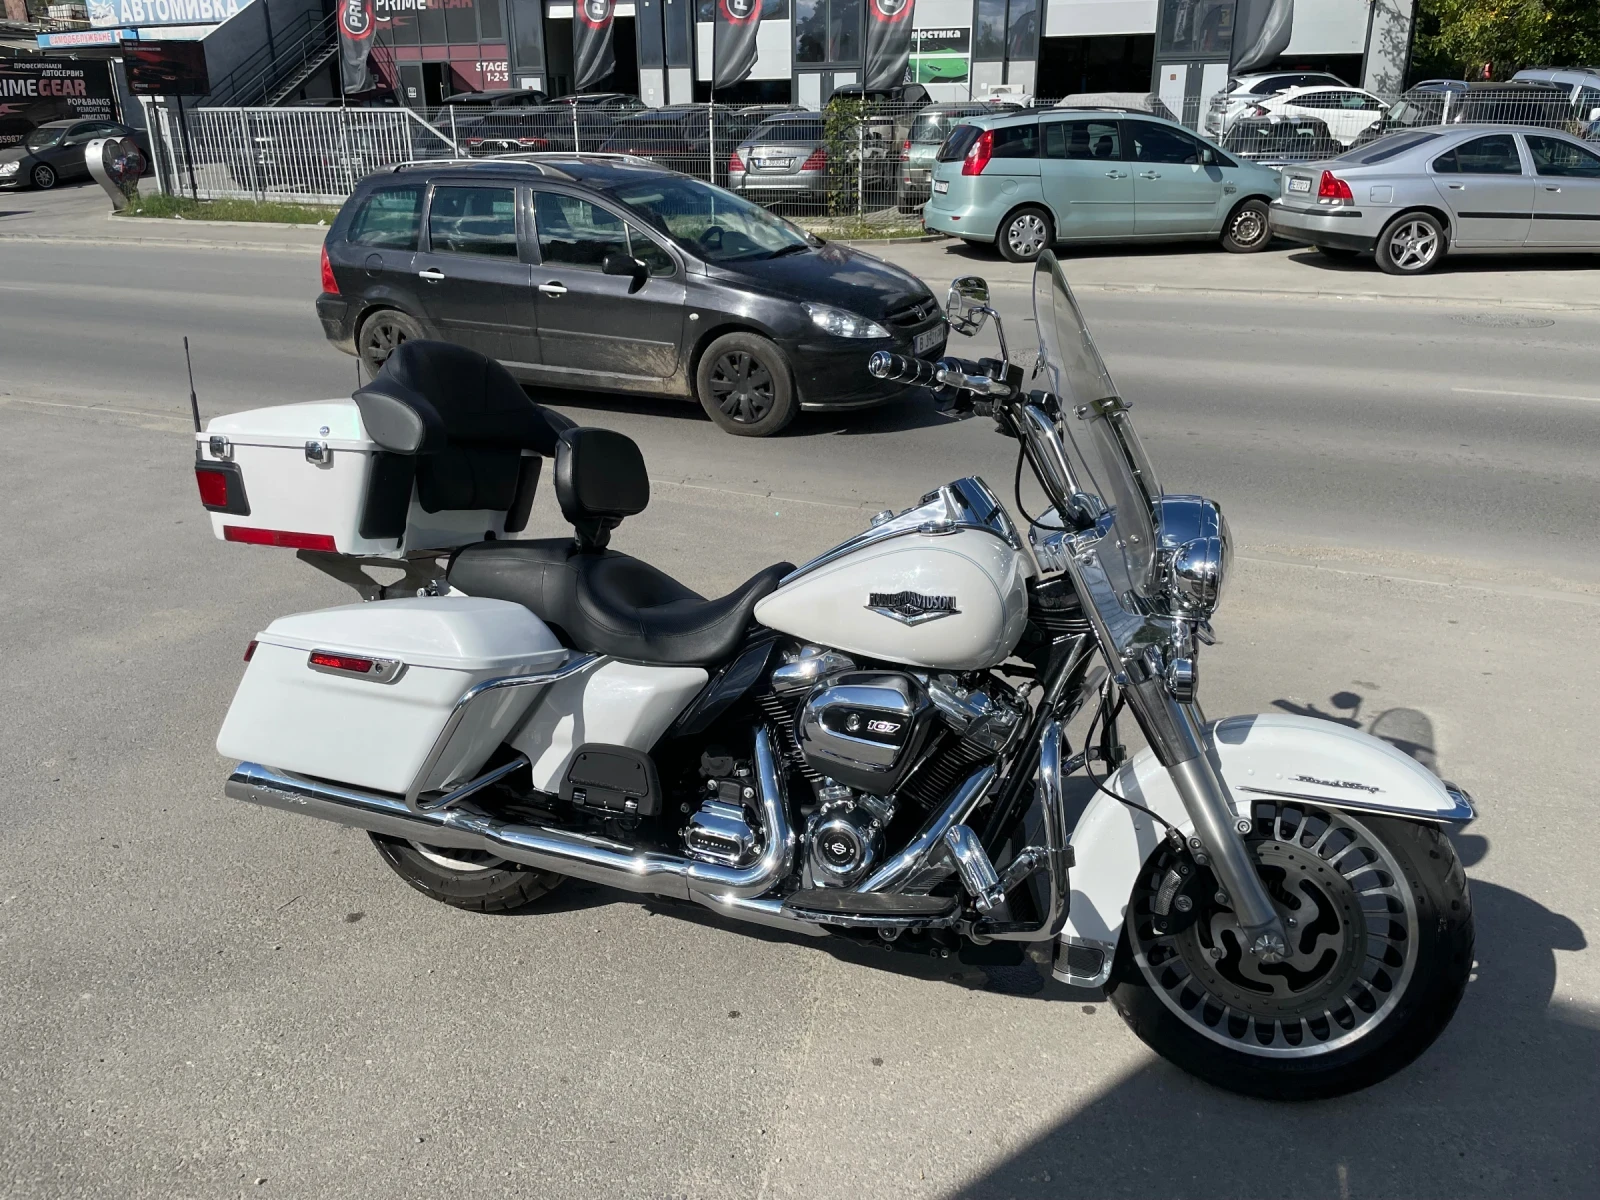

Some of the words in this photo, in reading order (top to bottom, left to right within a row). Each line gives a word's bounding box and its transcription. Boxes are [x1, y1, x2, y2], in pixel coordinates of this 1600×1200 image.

[120, 0, 239, 22] АВТОМИВКА
[475, 62, 508, 71] STAGE
[41, 69, 84, 77] АВТОСЕРВИЗ
[487, 73, 509, 82] 1-2-3
[38, 79, 87, 96] GEAR
[67, 98, 111, 106] POP&BANGS
[867, 720, 901, 733] 107
